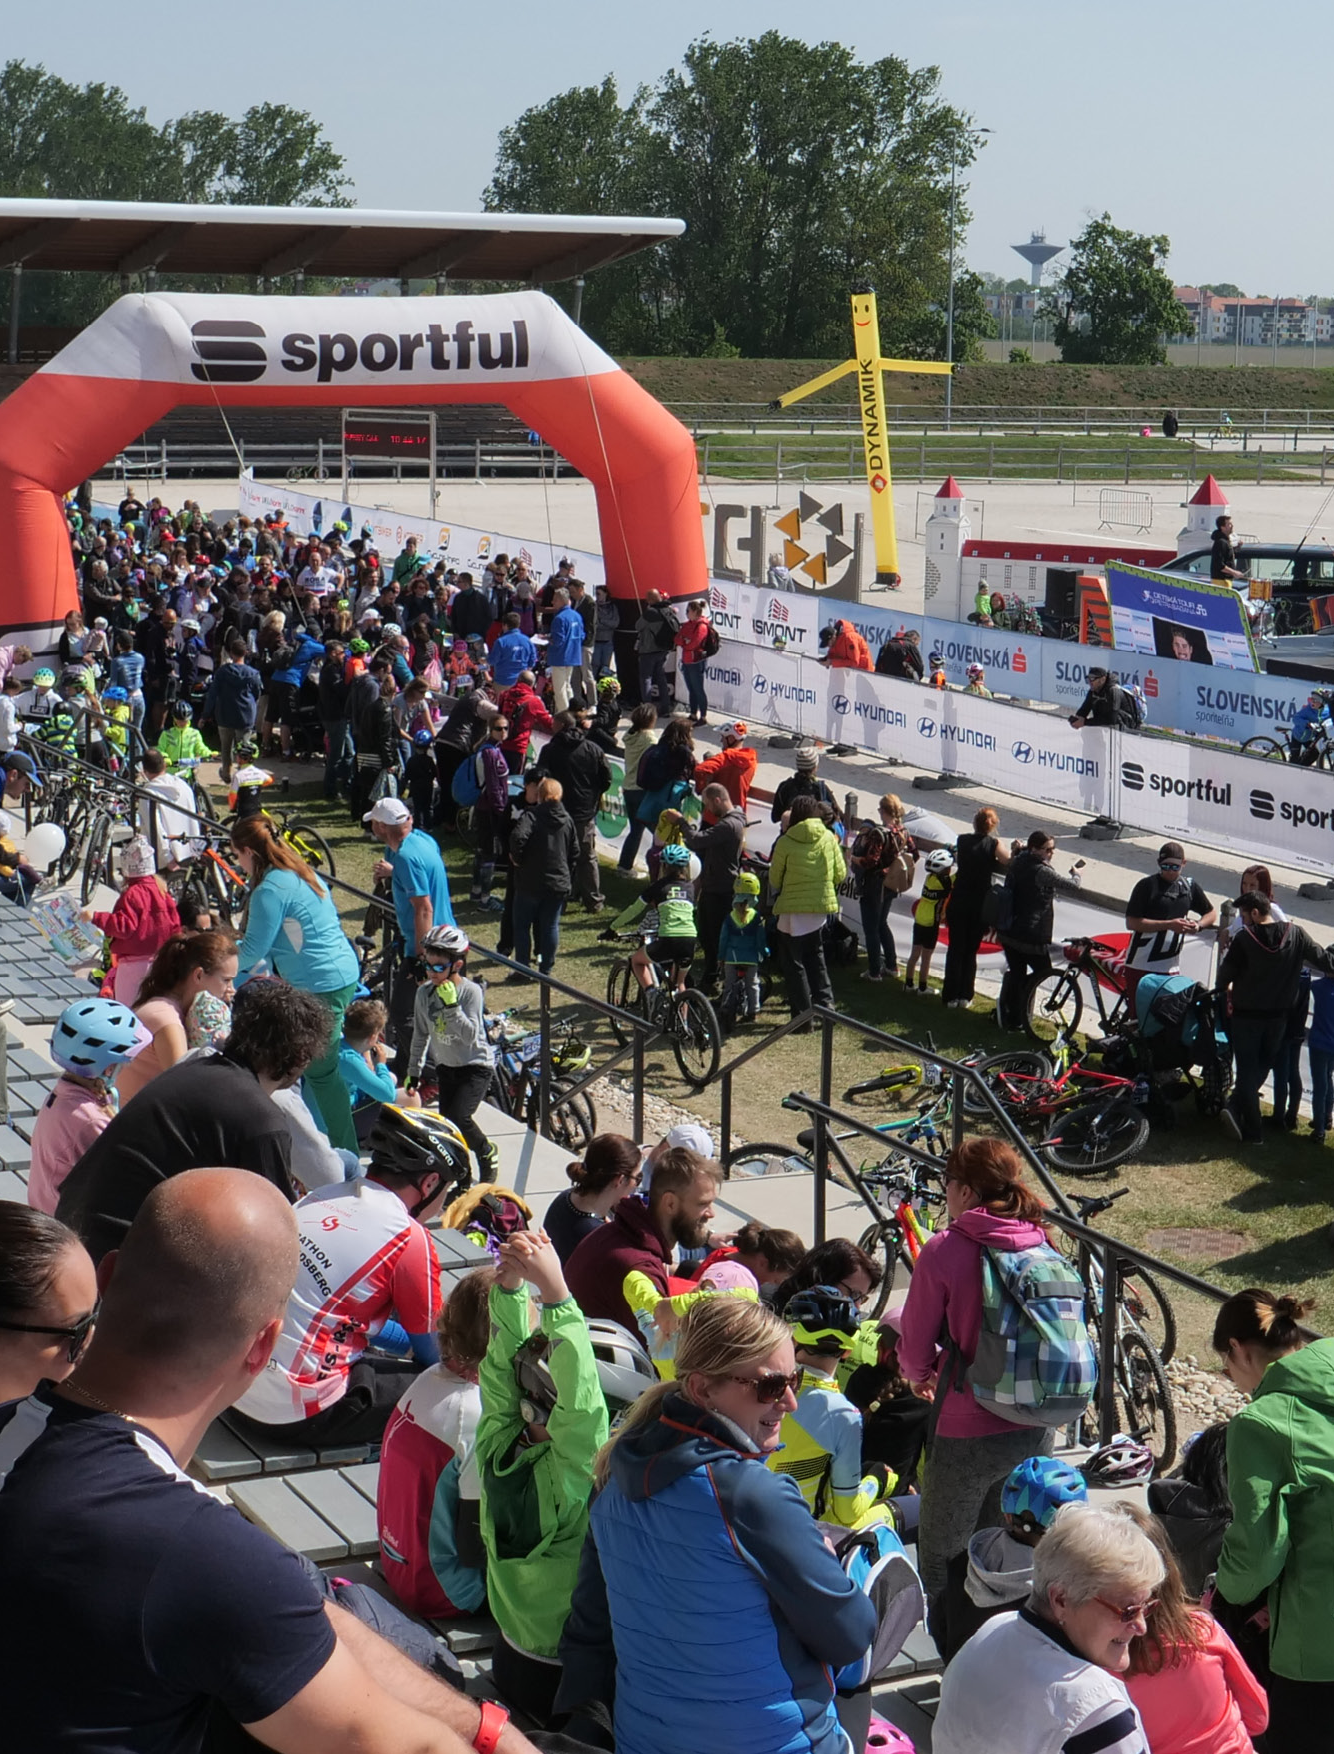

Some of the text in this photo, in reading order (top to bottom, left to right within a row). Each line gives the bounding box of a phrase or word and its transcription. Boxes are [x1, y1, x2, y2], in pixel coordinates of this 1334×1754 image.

[281, 320, 529, 382] sportful
[860, 359, 883, 470] DYNAMIK
[933, 639, 1010, 671] SLOVENSKÁ
[703, 667, 741, 686] YUNDAI
[770, 682, 816, 705] HYUNDAI
[1197, 686, 1297, 723] SLOVENSKÁ
[854, 701, 907, 728] HYUNDAI
[1196, 710, 1235, 728] sporiteľňa
[940, 723, 996, 752] HYUNDAI
[1038, 749, 1099, 778] HYUNDAI
[1149, 772, 1232, 806] sportful
